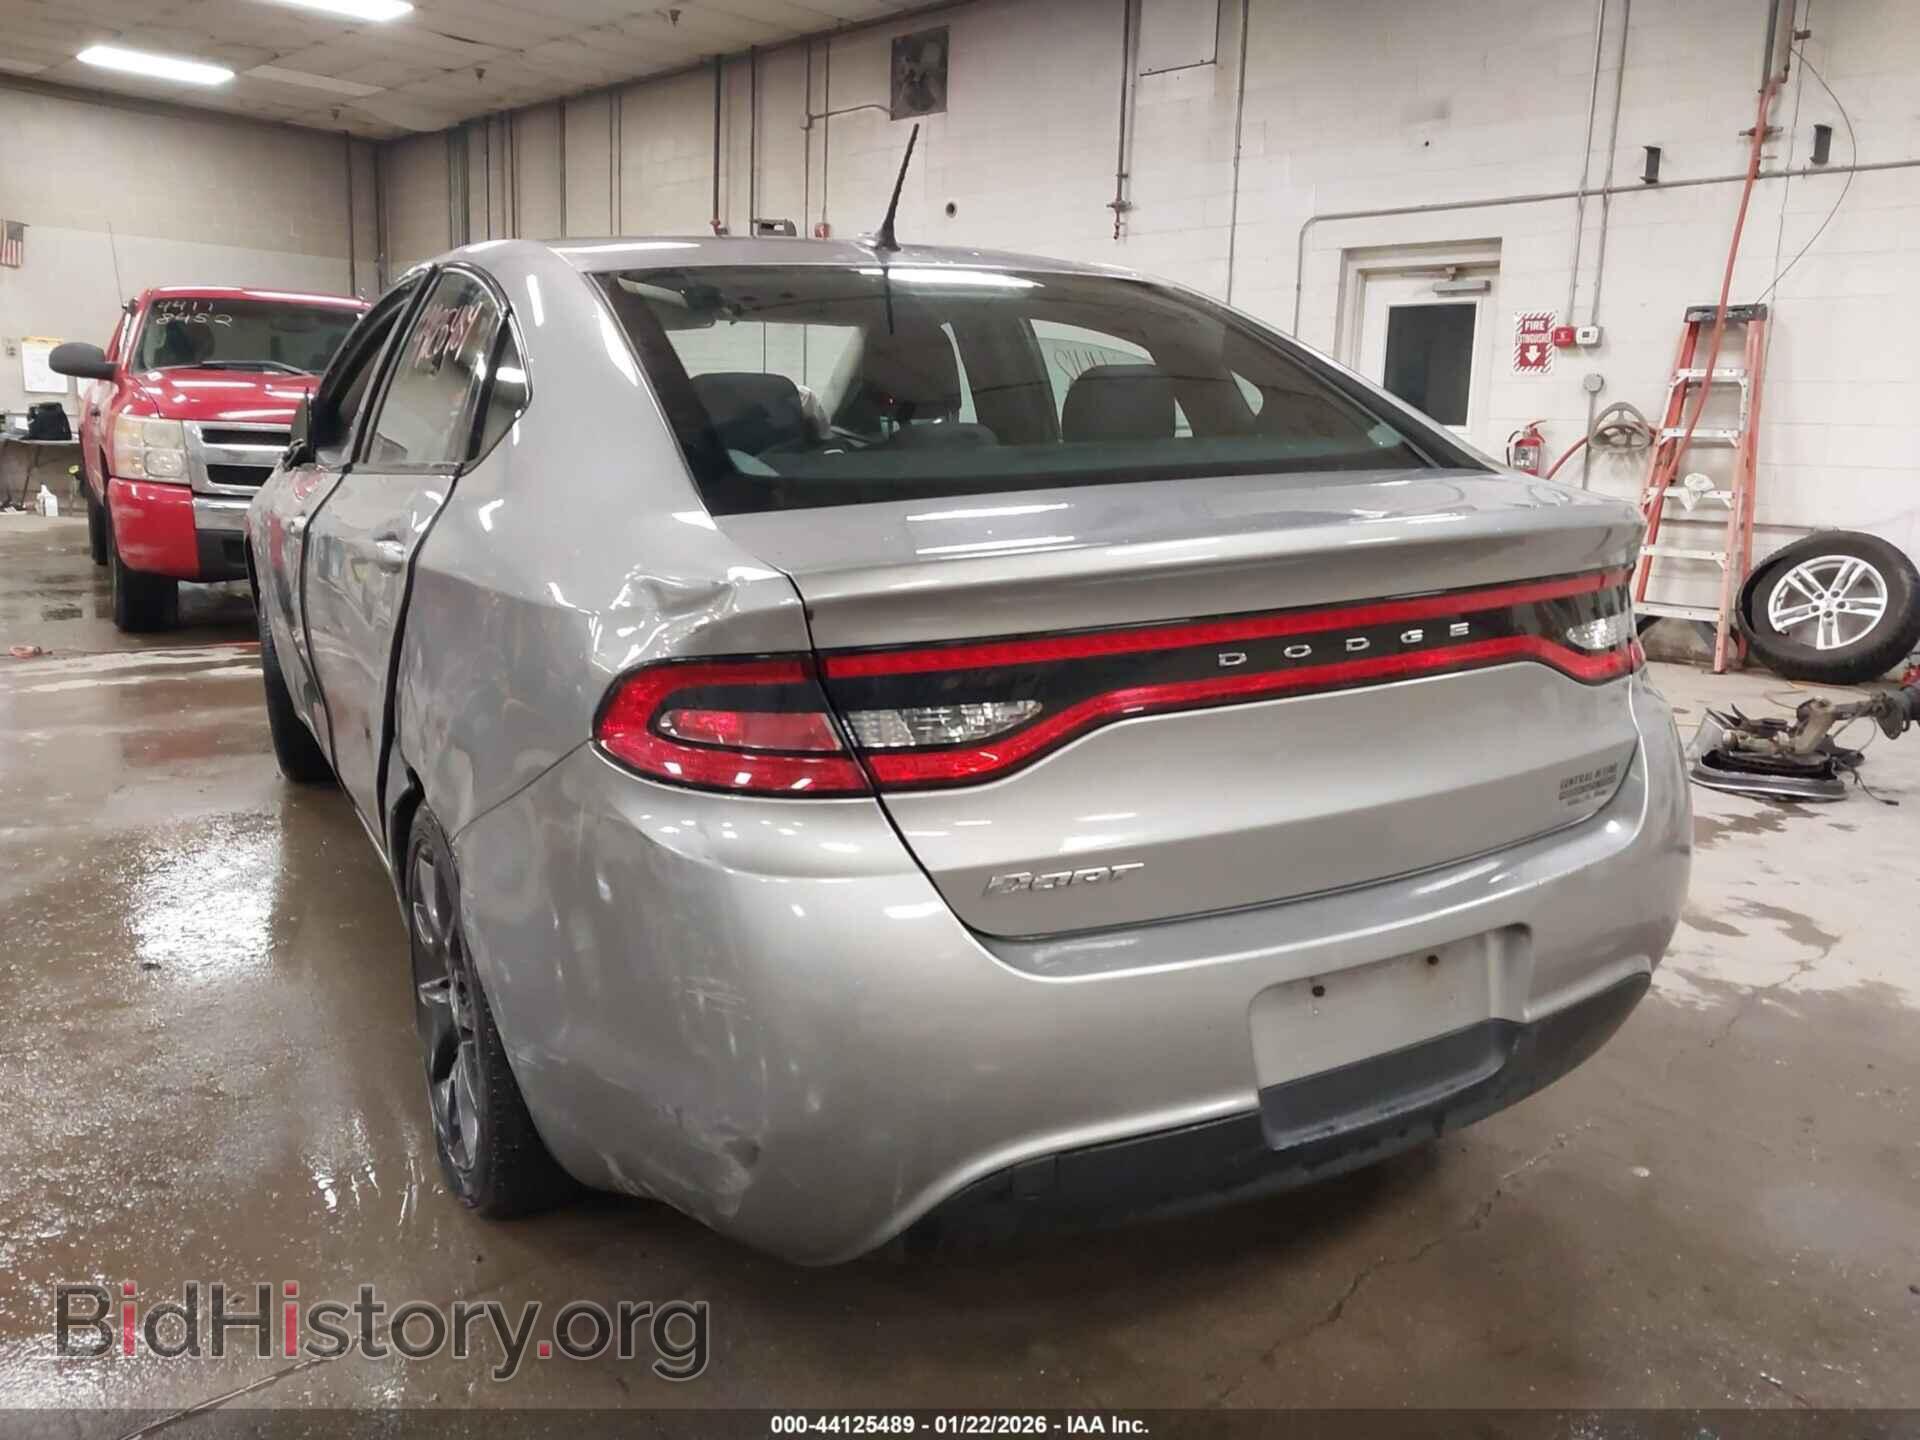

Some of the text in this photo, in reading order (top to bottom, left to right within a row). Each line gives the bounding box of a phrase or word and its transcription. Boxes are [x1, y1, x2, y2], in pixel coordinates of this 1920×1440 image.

[156, 312, 233, 328] 8452
[1524, 320, 1546, 331] FIRE
[1217, 621, 1470, 667] DODGE
